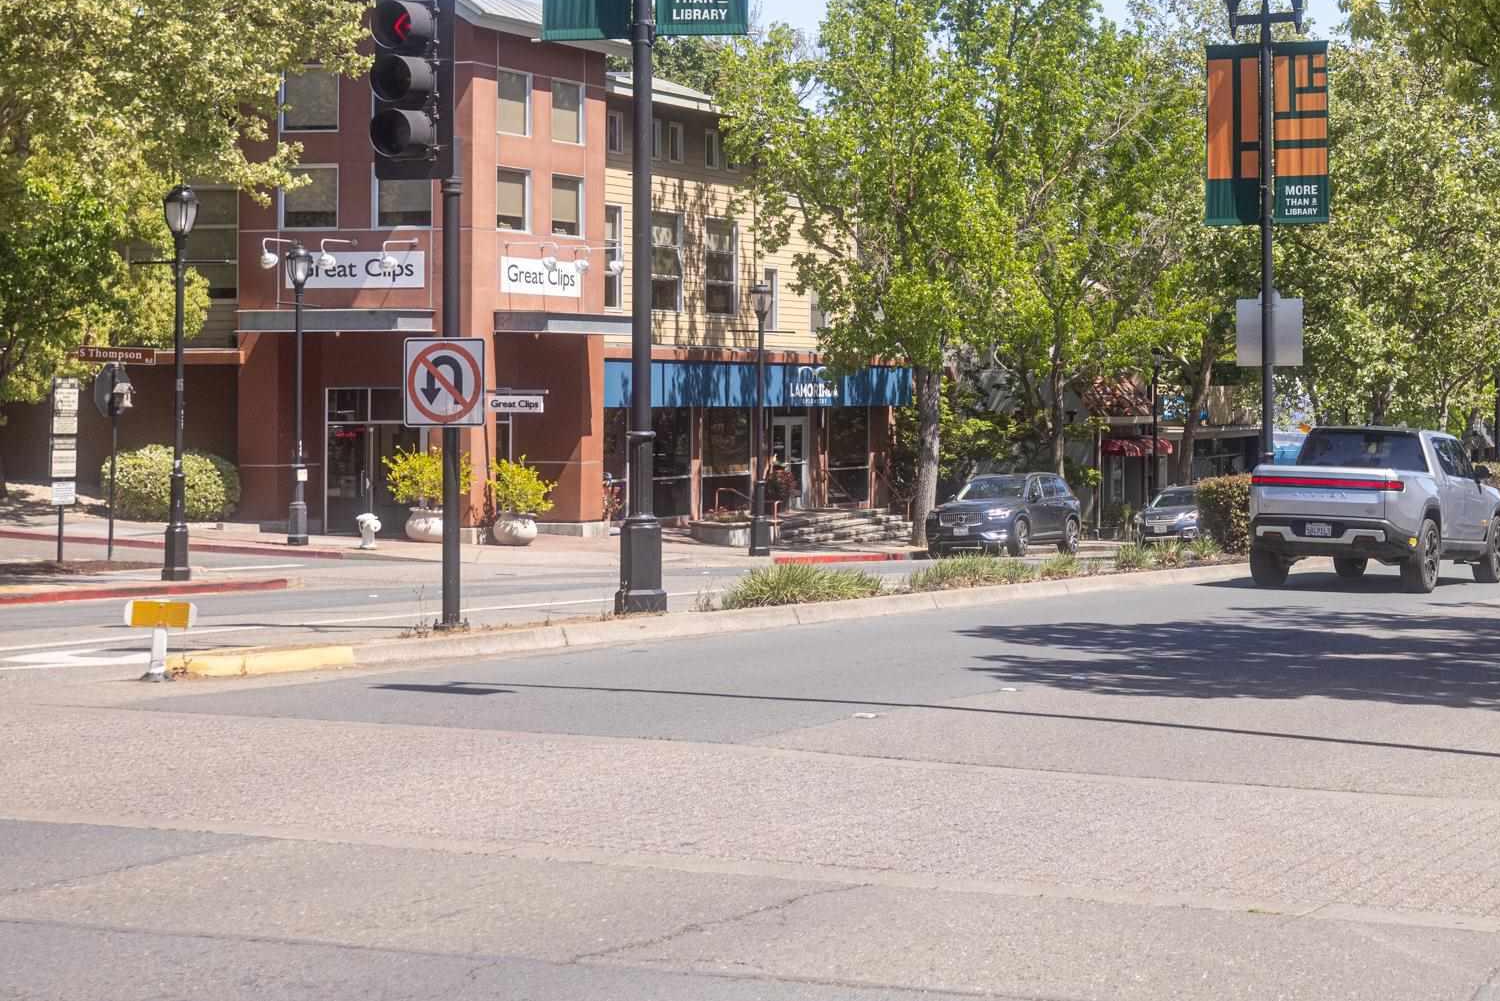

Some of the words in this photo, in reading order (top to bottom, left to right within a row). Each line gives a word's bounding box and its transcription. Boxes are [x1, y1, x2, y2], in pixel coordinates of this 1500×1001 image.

[672, 8, 728, 21] LIBRARY
[1284, 184, 1319, 196] MORE
[1285, 198, 1310, 207] THAN
[1284, 207, 1318, 216] LIBRARY
[507, 264, 545, 285] Great
[548, 266, 576, 292] Clips
[88, 348, 142, 361] Thompson
[490, 399, 517, 408] Great
[518, 399, 539, 410] Clips
